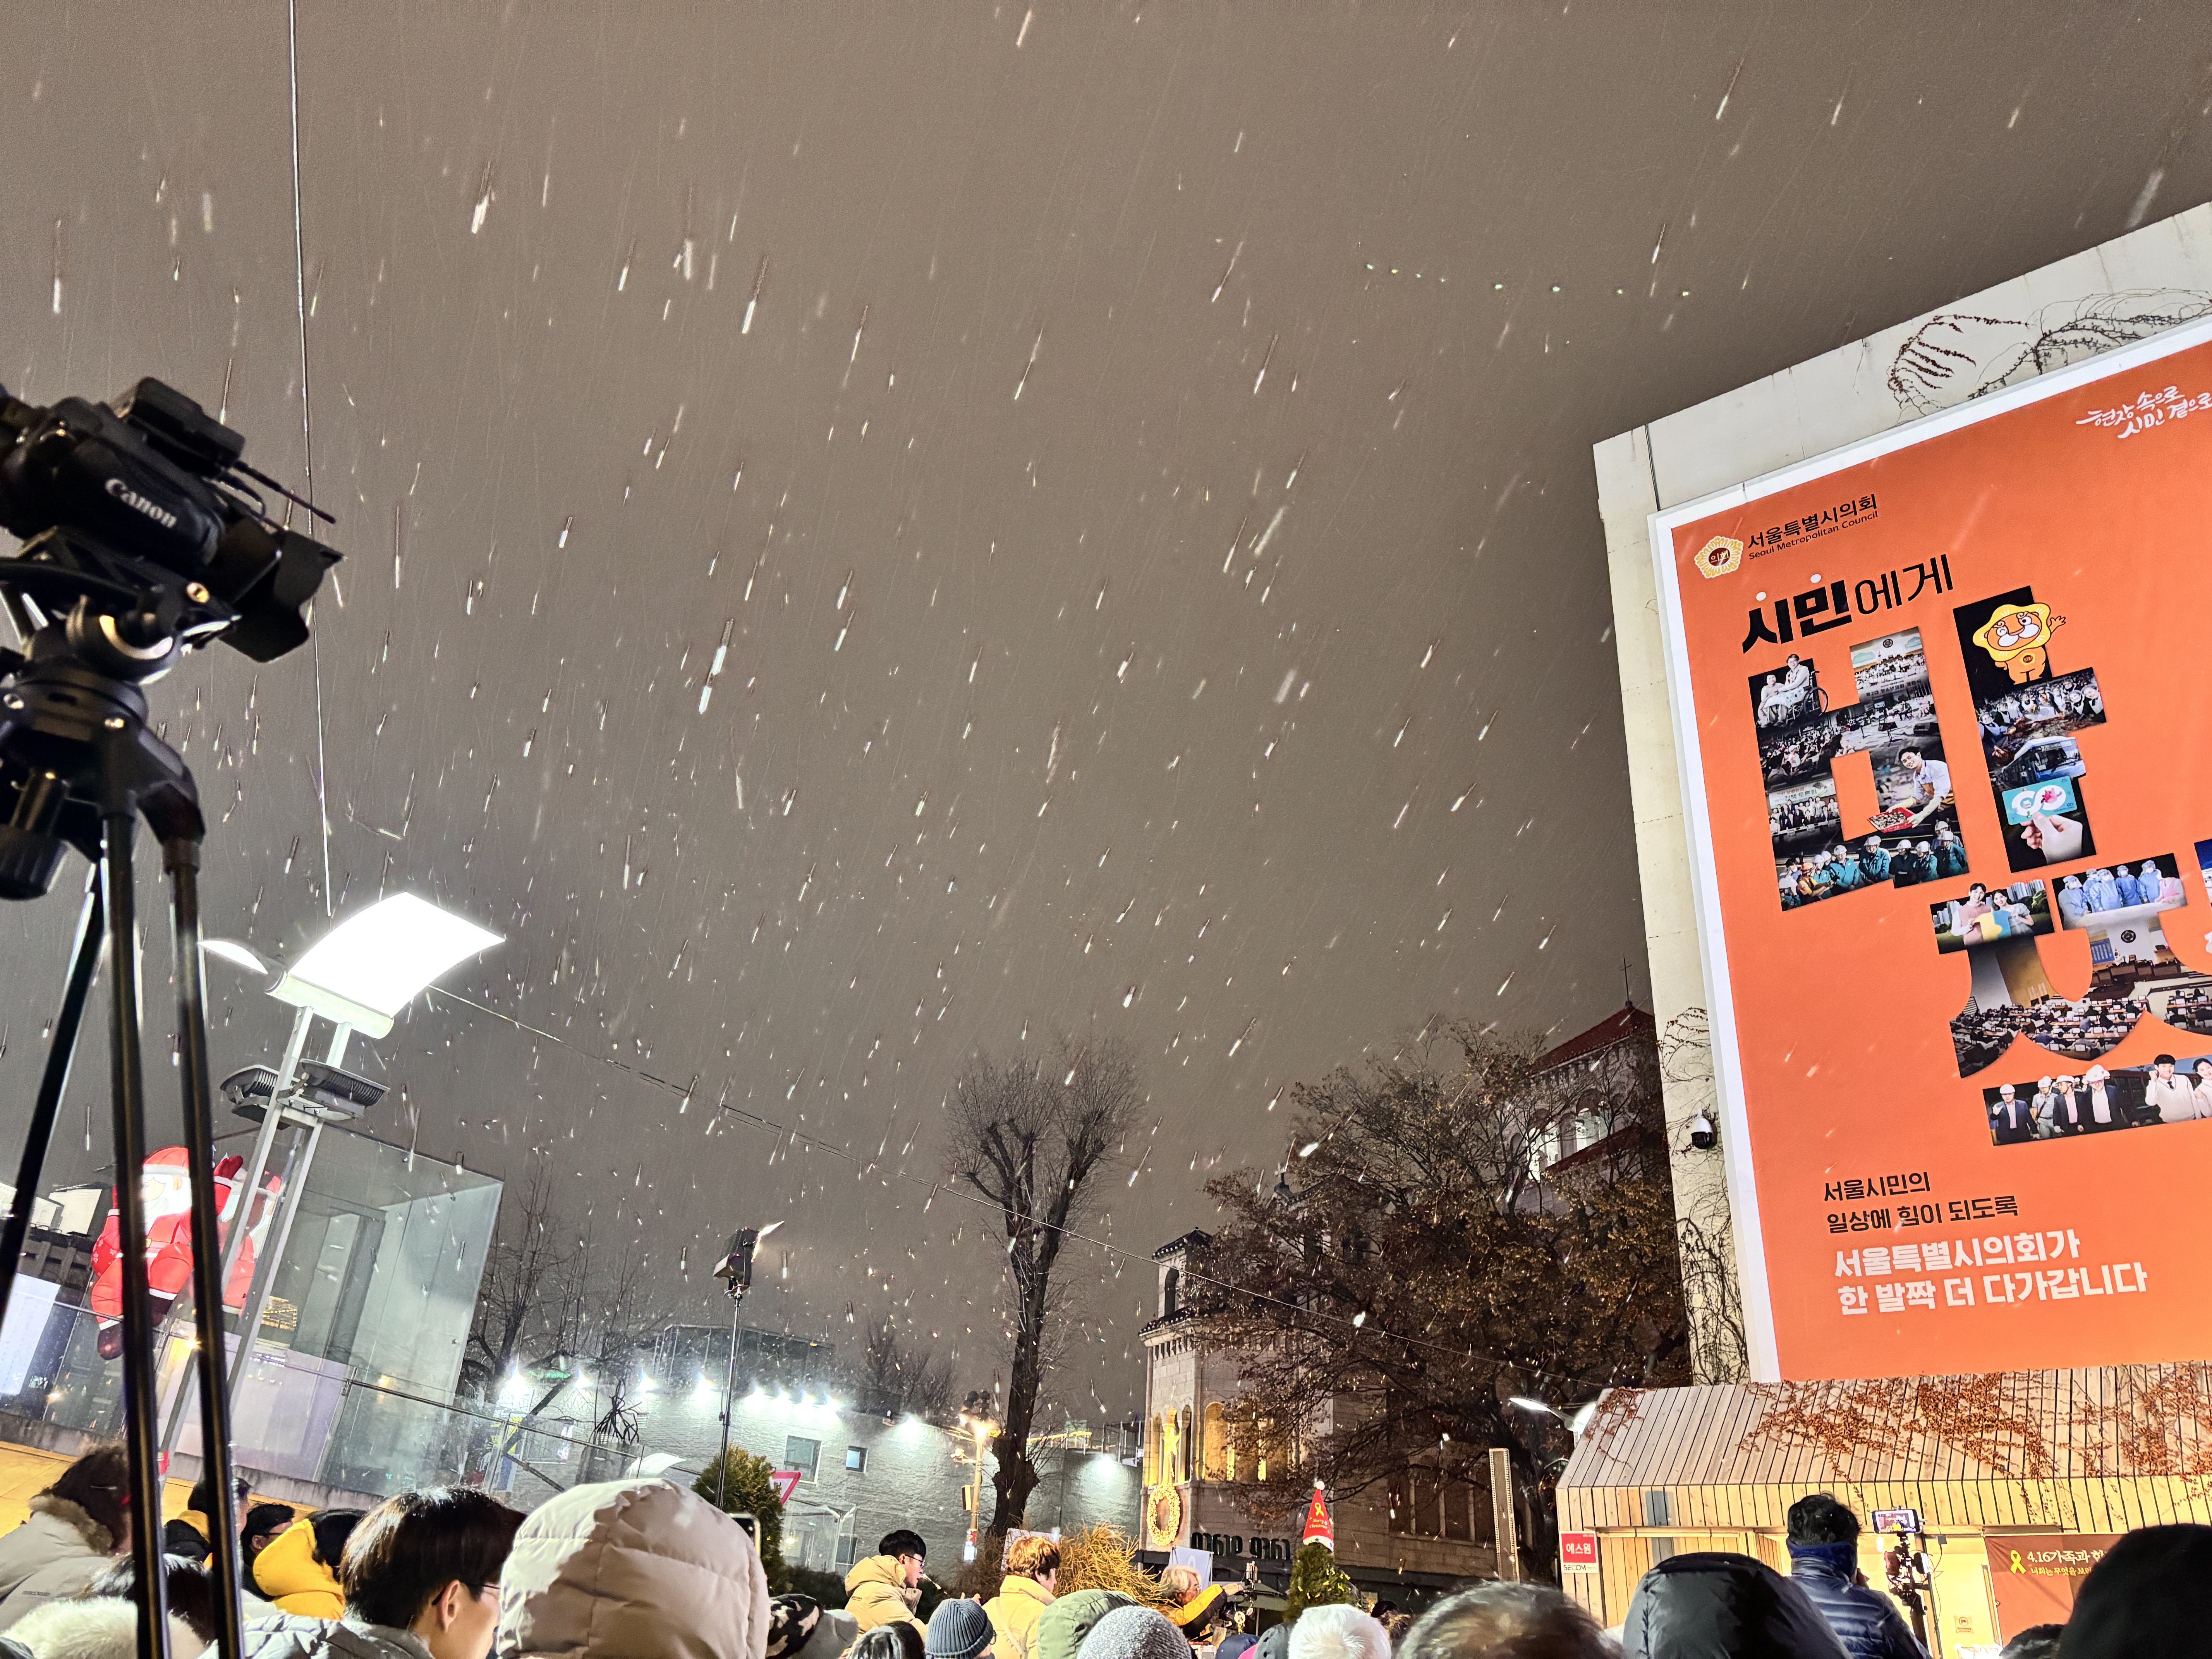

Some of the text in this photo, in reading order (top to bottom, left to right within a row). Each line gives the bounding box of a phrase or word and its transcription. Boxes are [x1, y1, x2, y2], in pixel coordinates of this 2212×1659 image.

[2075, 386, 2185, 427] 현장 속으로
[2117, 392, 2212, 439] 시민 곁으로
[105, 478, 177, 528] Canon
[1748, 493, 1877, 549] 서울특별시의회
[1710, 550, 1729, 563] 의회
[1749, 510, 1878, 560] Seoul Metropolitan Council
[1742, 554, 1954, 654] 시민에게
[1823, 1171, 1931, 1202] 서울시민의
[1827, 1195, 2019, 1233] 일상에 힘이 되도록
[1834, 1229, 2081, 1278] 서울특별시의회가
[1837, 1262, 2148, 1316] 한 발짝 더 다가갑니다
[1566, 1543, 1592, 1554] 에스원
[2027, 1549, 2091, 1565] 4.16가족과
[2030, 1566, 2054, 1577] 너희는
[2054, 1566, 2076, 1577] 무엇을
